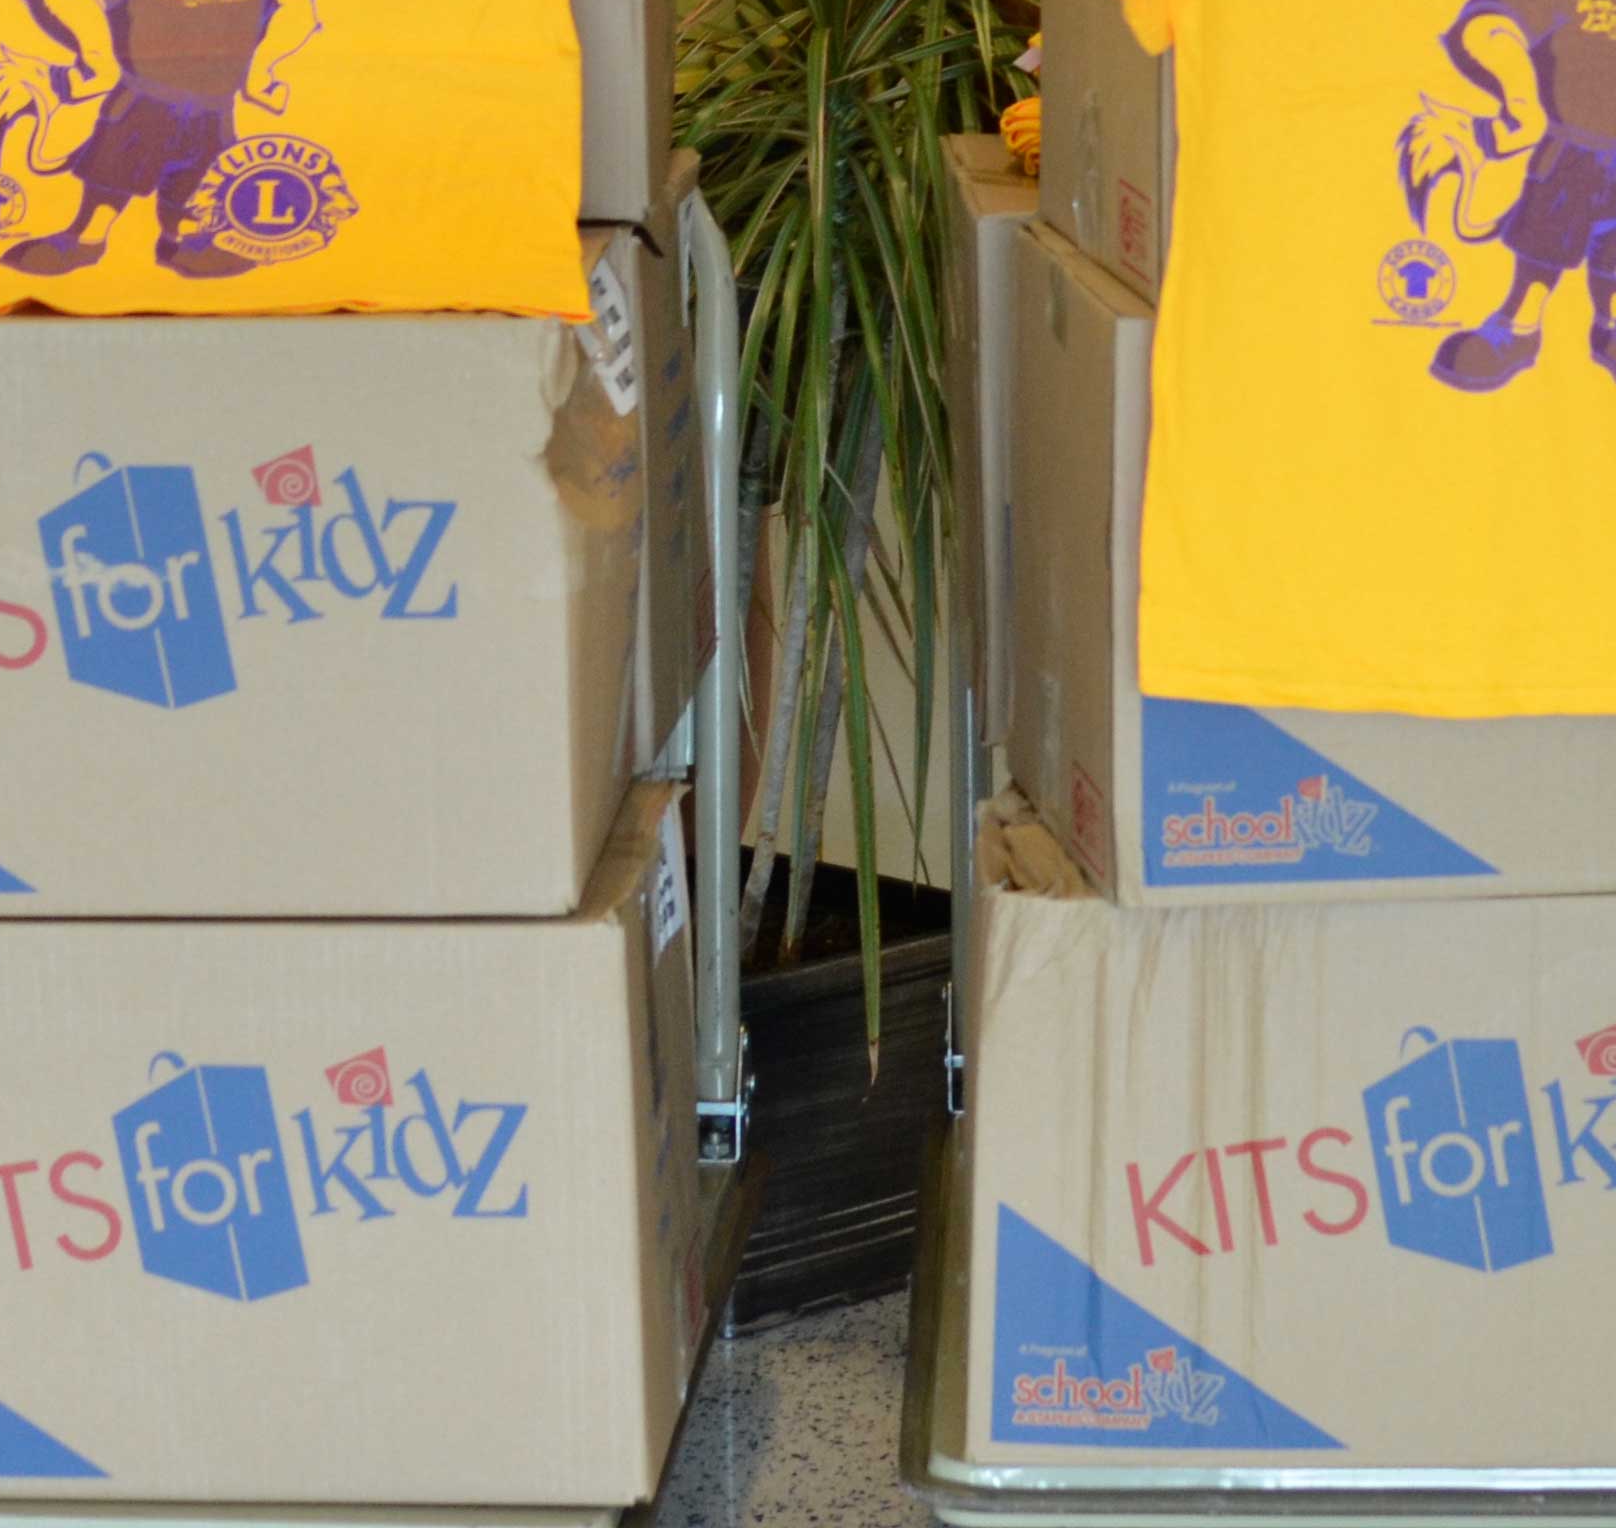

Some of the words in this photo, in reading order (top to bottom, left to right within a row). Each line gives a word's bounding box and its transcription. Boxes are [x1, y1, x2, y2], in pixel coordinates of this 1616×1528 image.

[226, 141, 322, 170] LIONS
[252, 179, 295, 224] L
[60, 524, 198, 639] for
[219, 452, 458, 624] kidz
[135, 1120, 273, 1233] for
[292, 1054, 529, 1223] kidz
[1124, 1126, 1368, 1267] KITS
[1383, 1097, 1522, 1205] for
